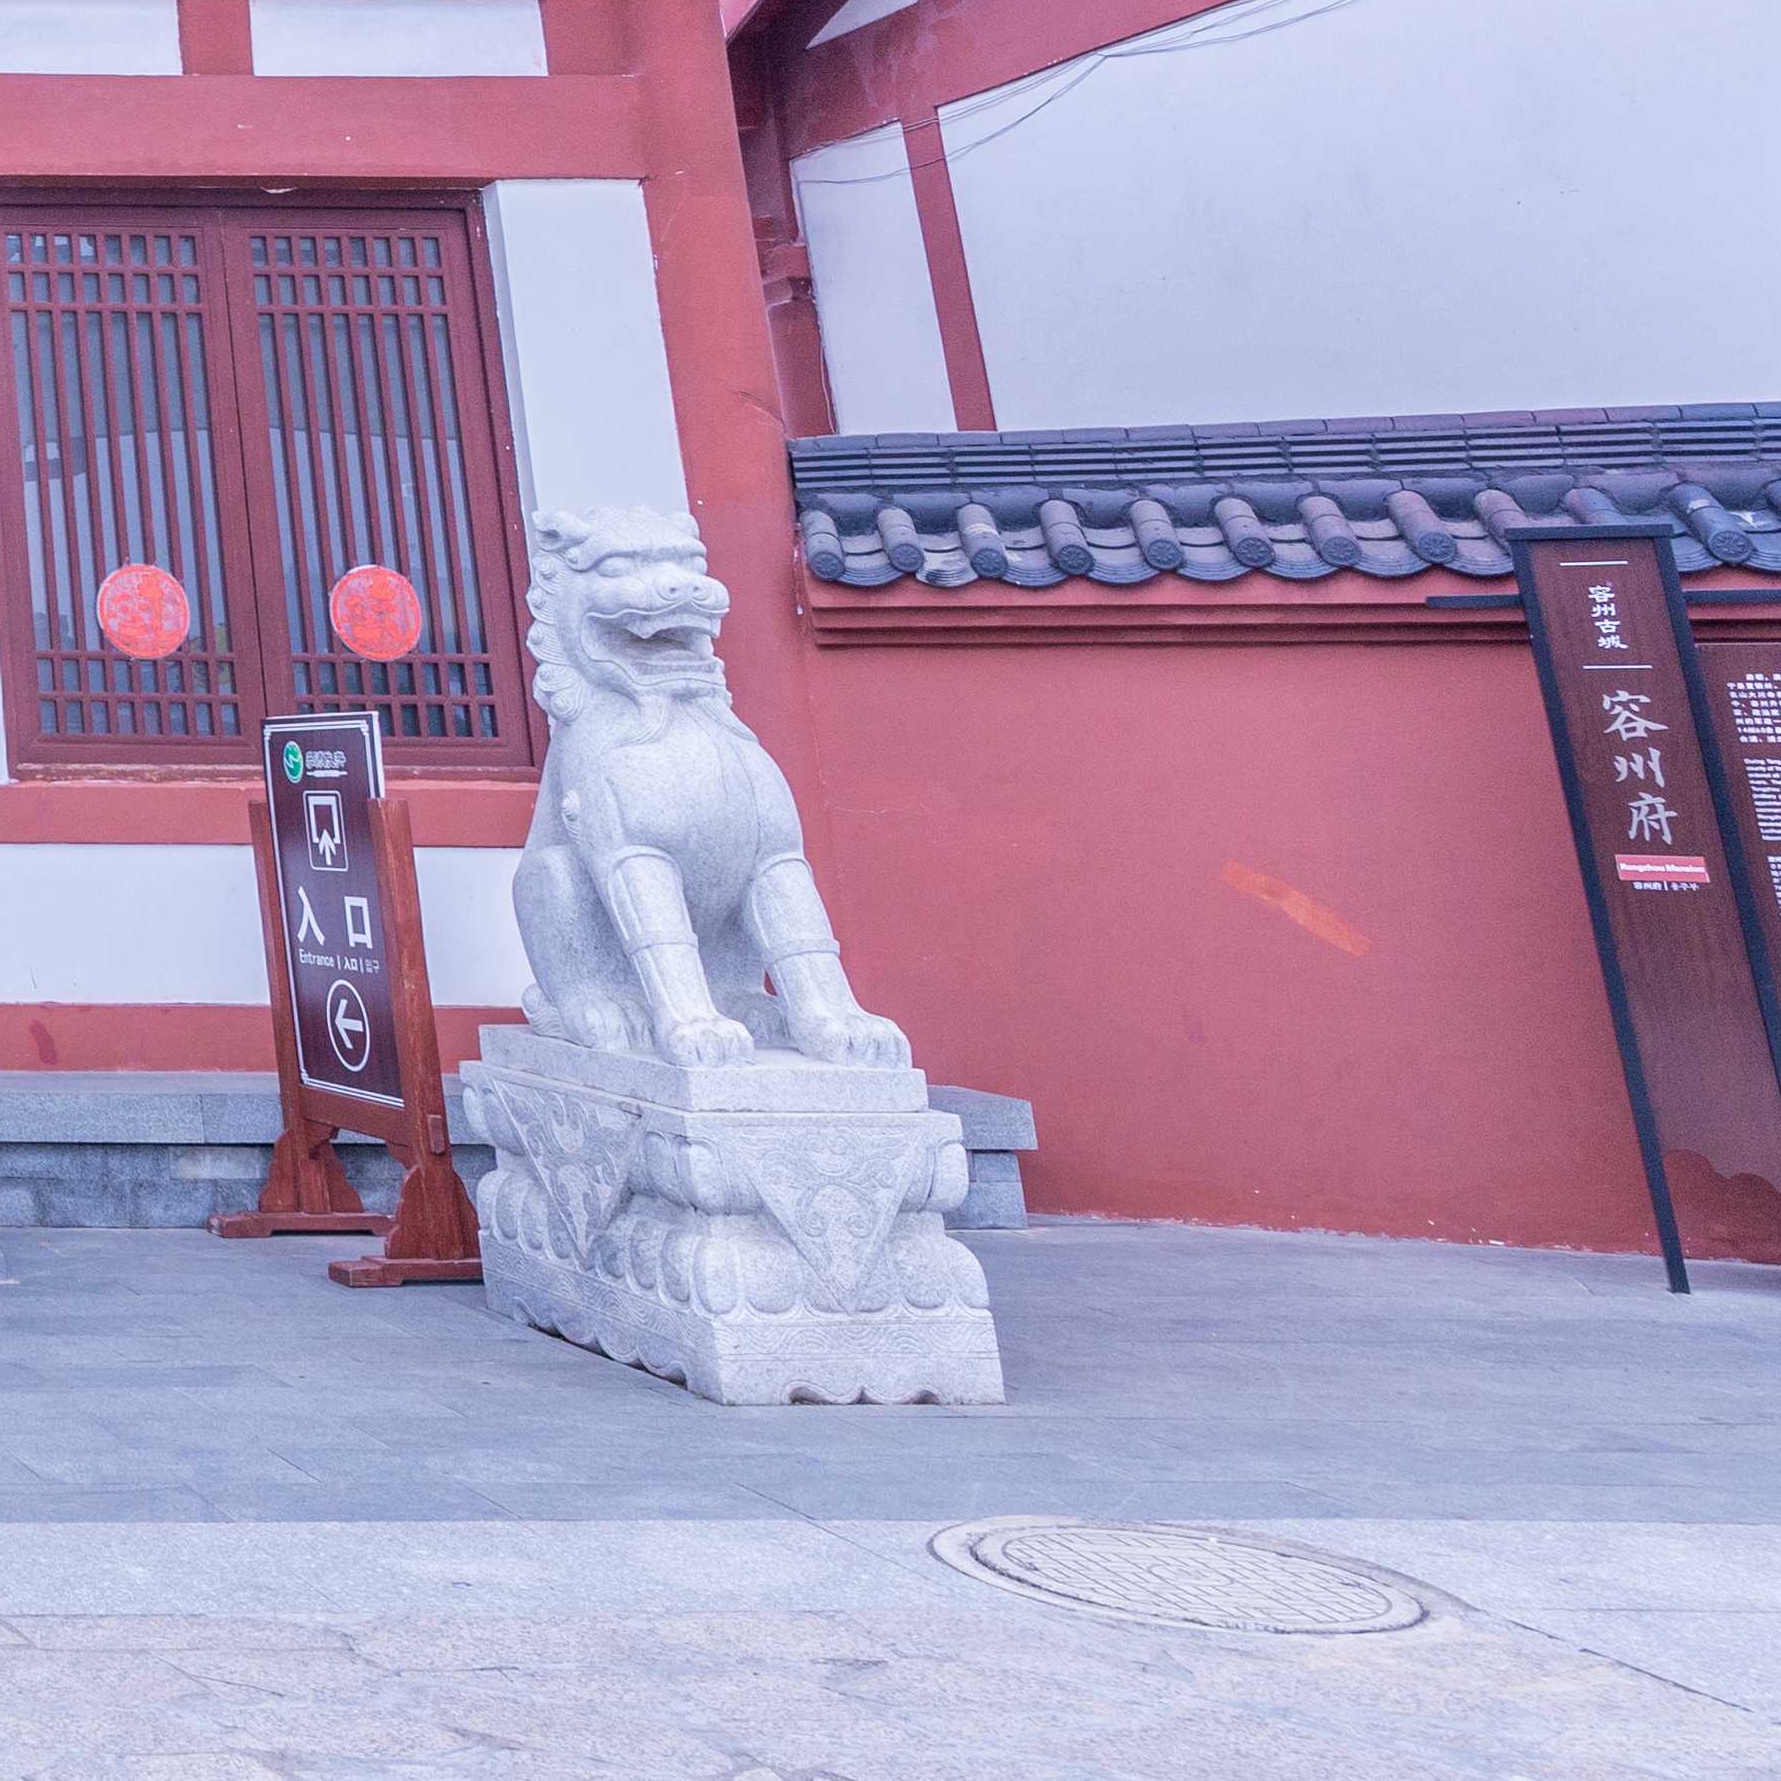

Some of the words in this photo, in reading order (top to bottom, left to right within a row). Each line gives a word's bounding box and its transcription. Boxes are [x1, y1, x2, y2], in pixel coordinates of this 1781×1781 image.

[1603, 690, 1679, 845] 容州府
[297, 885, 373, 949] 入口
[299, 948, 335, 968] Entrance
[343, 956, 359, 972] 入口
